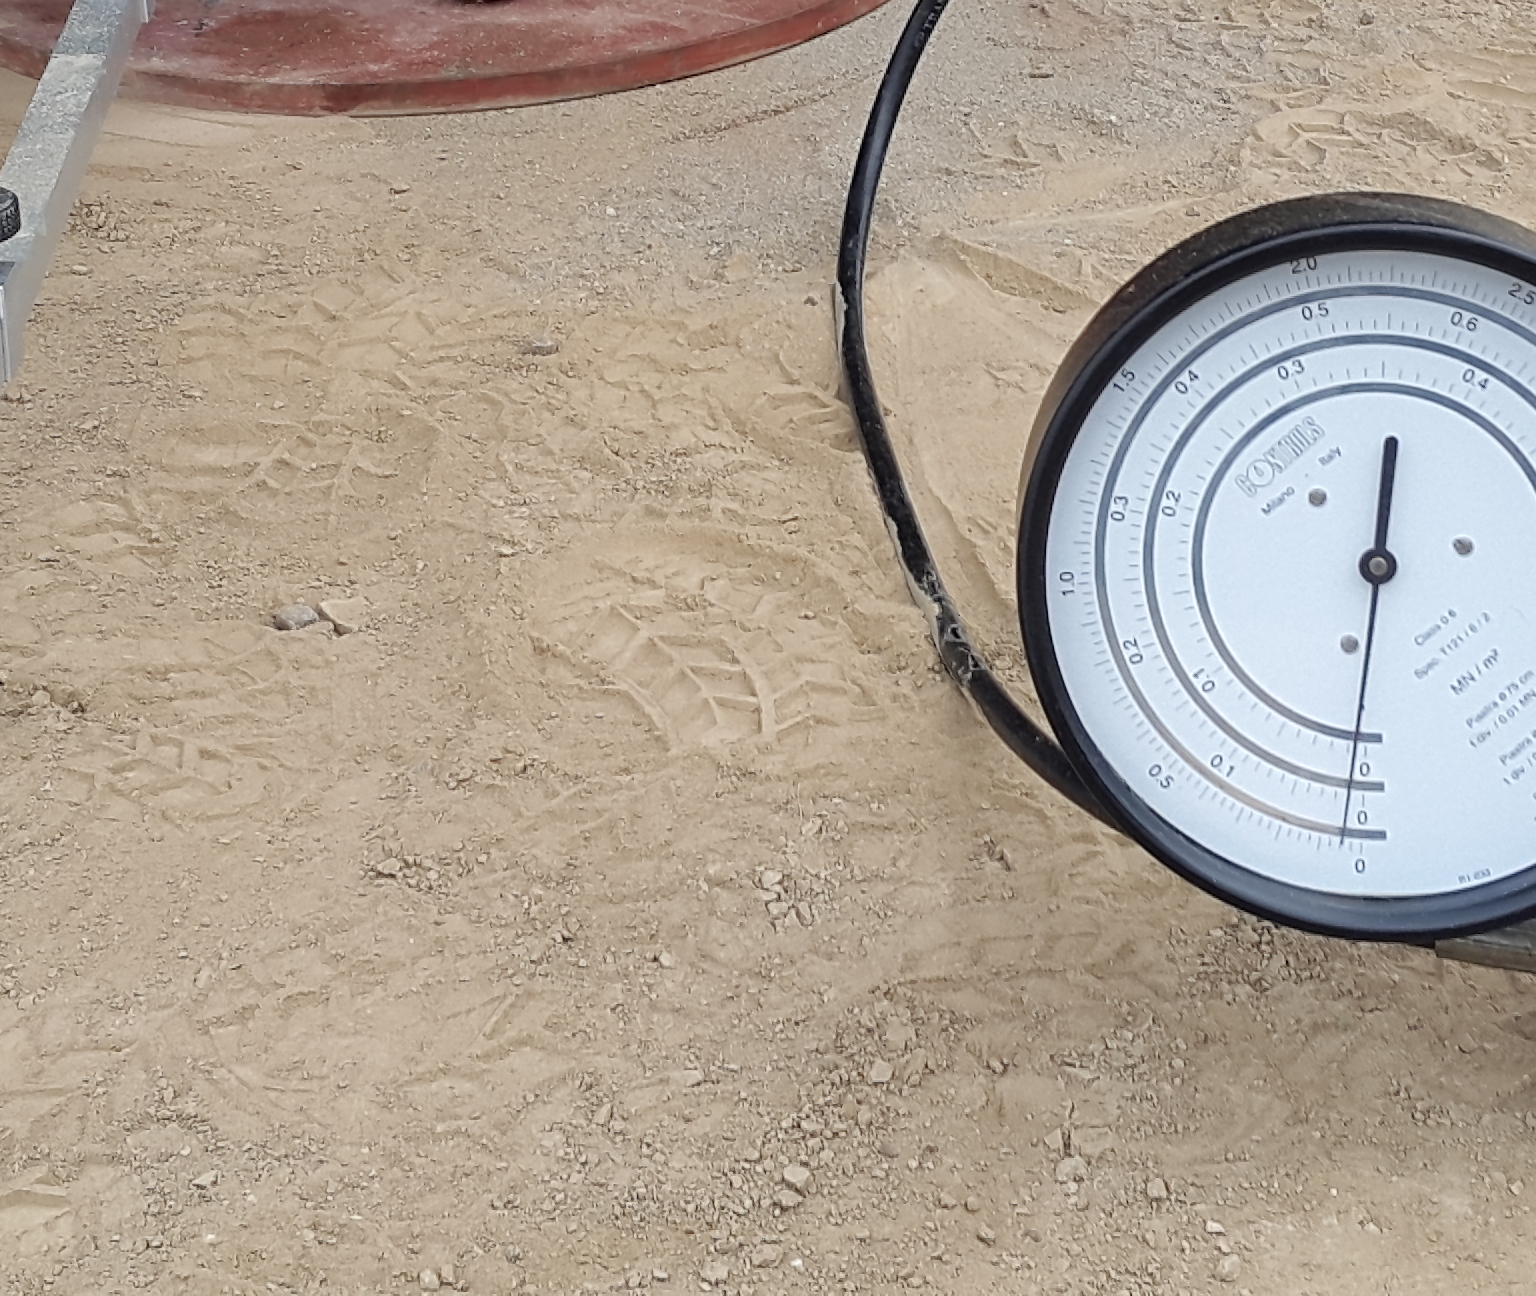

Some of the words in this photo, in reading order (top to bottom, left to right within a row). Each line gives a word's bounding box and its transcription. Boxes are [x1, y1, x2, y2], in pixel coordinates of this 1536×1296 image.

[1289, 256, 1317, 275] 2.0
[1508, 282, 1536, 305] 2.5
[1302, 303, 1330, 320] 0.5
[1450, 311, 1477, 332] 0.6
[1112, 370, 1135, 393] 1.5
[1277, 360, 1305, 380] 0.3
[1462, 368, 1489, 390] 0.4
[1174, 370, 1199, 395] 0.4
[1111, 496, 1129, 522] 0.3
[1161, 490, 1181, 518] 0.2
[1060, 571, 1075, 596] 1.0
[1123, 637, 1144, 664] 0.2
[1192, 667, 1216, 692] 0.1
[1148, 763, 1175, 790] 0.5
[1210, 754, 1236, 778] 0.1
[1360, 762, 1370, 776] 0
[1357, 810, 1368, 825] 0
[1355, 858, 1366, 873] 0
